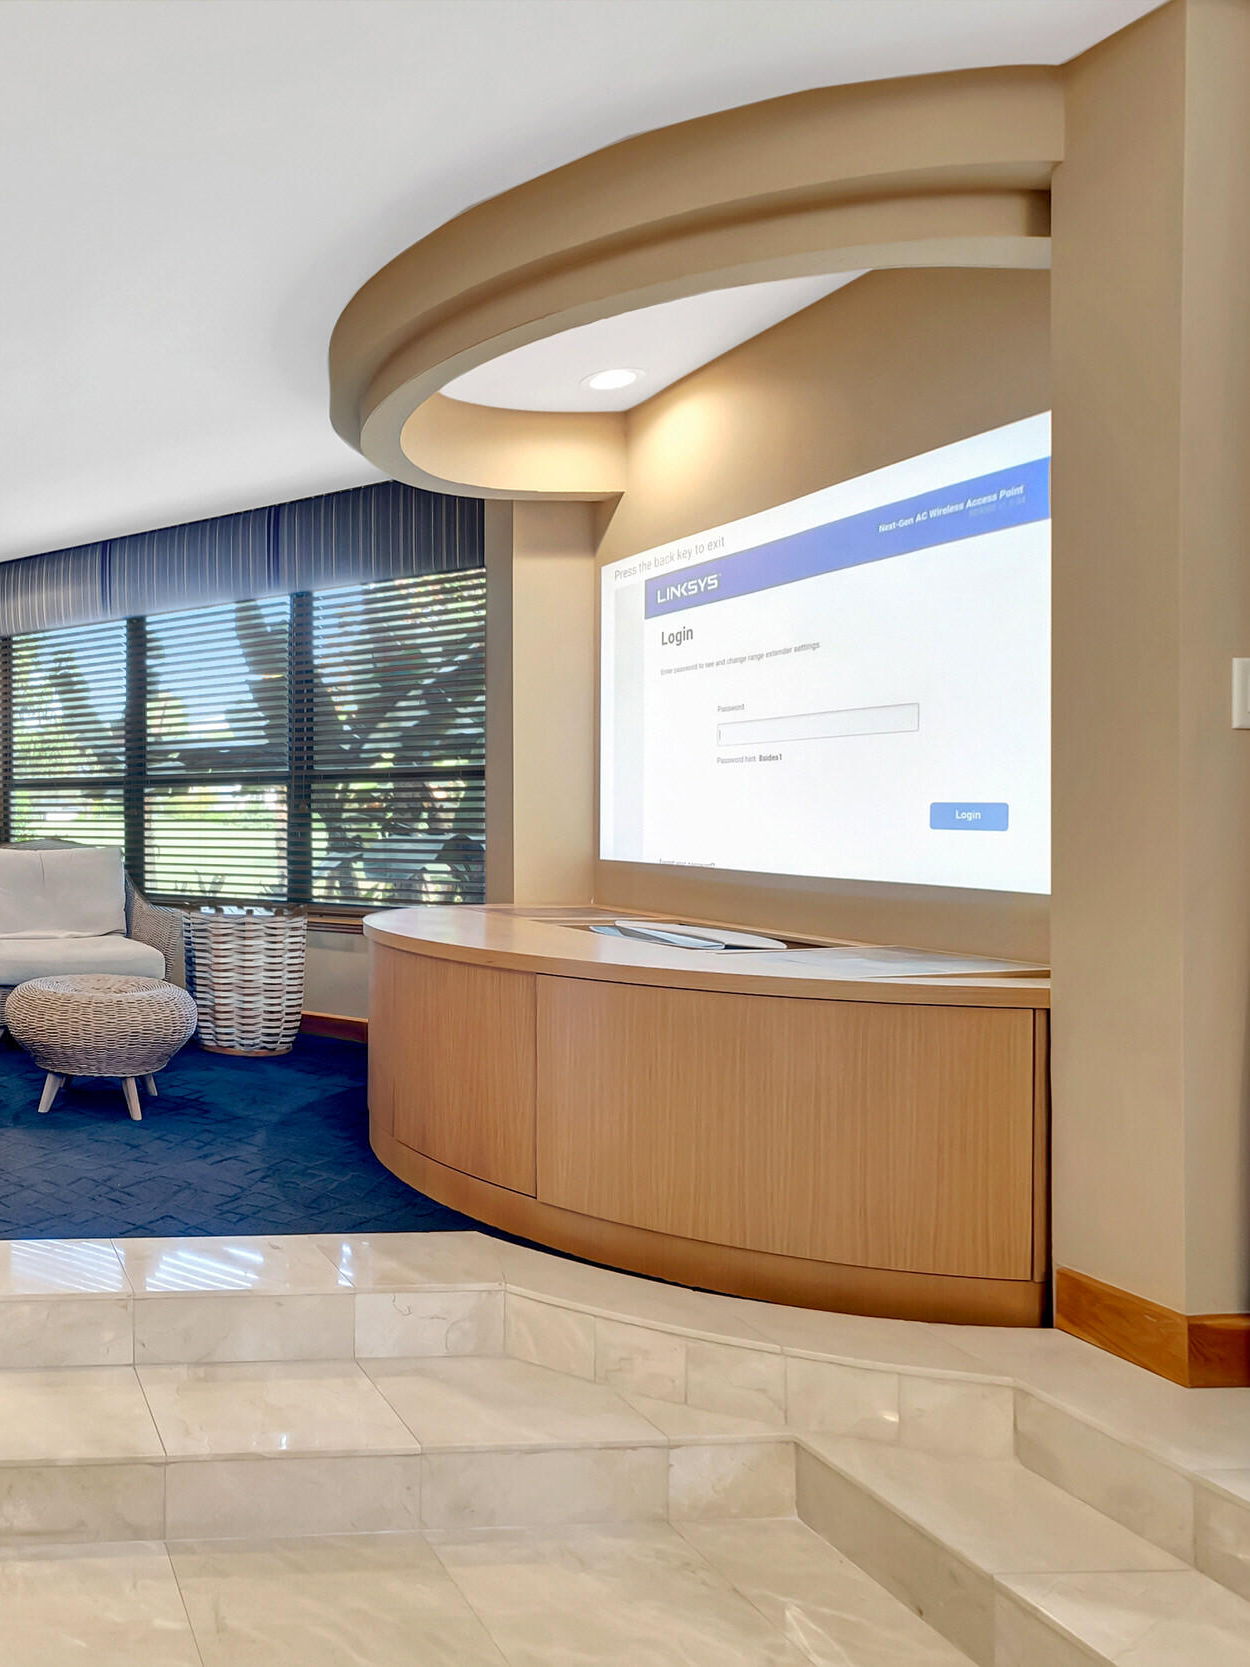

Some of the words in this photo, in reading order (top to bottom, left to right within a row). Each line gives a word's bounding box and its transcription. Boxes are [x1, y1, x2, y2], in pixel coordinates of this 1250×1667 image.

[878, 516, 914, 533] Next-Gen
[915, 511, 928, 524] AC
[929, 501, 964, 519] Wireless
[965, 492, 998, 509] Access
[999, 484, 1025, 500] Point
[614, 567, 637, 581] Press
[638, 560, 652, 572] the
[653, 551, 676, 568] back
[677, 547, 693, 561] key
[695, 544, 705, 555] to
[707, 536, 725, 551] exit
[657, 574, 719, 604] LINKSYS
[661, 626, 694, 646] Login
[726, 655, 747, 665] change
[747, 652, 765, 661] range
[766, 647, 792, 658] extender
[717, 703, 745, 712] Password
[716, 756, 744, 764] Password
[955, 809, 982, 822] Login
